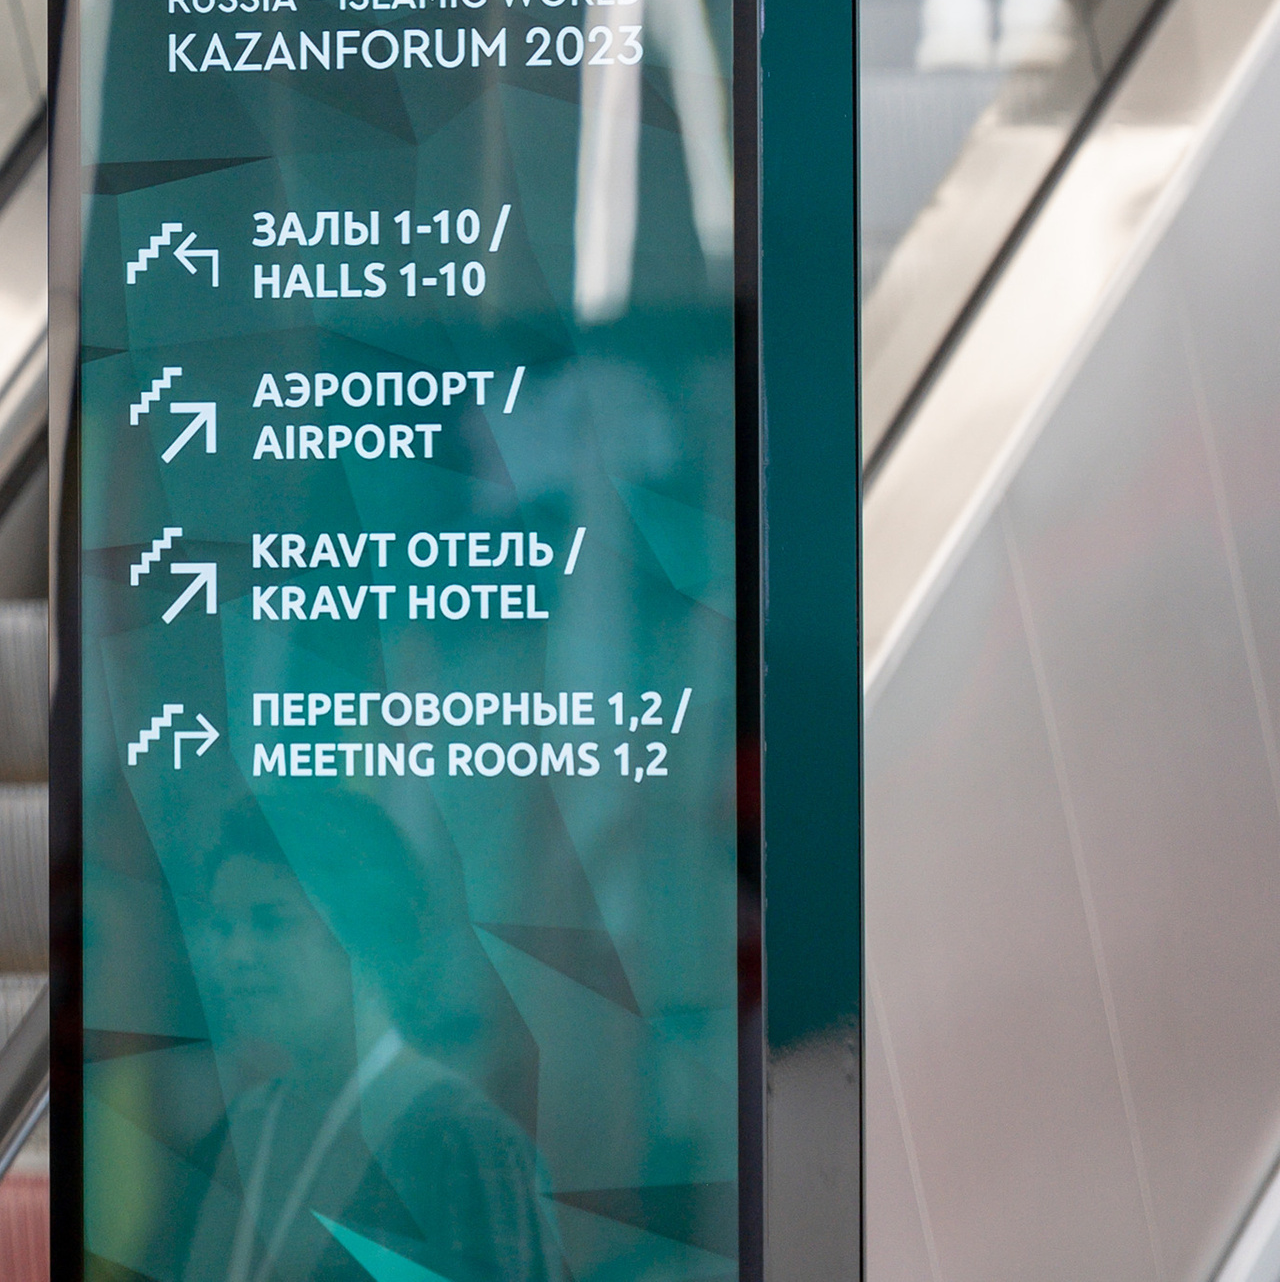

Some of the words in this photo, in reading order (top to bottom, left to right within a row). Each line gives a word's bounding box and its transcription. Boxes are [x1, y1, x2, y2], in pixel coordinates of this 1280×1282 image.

[169, 28, 506, 73] KAZANFORUM
[526, 25, 644, 67] 2023
[252, 211, 379, 247] ЗАЛЫ
[394, 209, 480, 245] 1-10
[254, 262, 386, 299] HALLS
[400, 261, 486, 297] 1-10
[253, 371, 494, 408] АЭРОПОРТ
[253, 424, 442, 460] AIRPORT
[252, 532, 396, 568] KRAVT
[408, 532, 553, 567] ОТЕЛЬ
[253, 585, 396, 620] KRAVT
[409, 584, 549, 620] HOTEL
[253, 692, 595, 727] ПЕРЕГОВОРНЫЕ
[608, 691, 663, 732] 1,2
[253, 742, 435, 777] MEETING
[448, 742, 600, 777] ROOMS
[614, 742, 668, 783] 1,2
